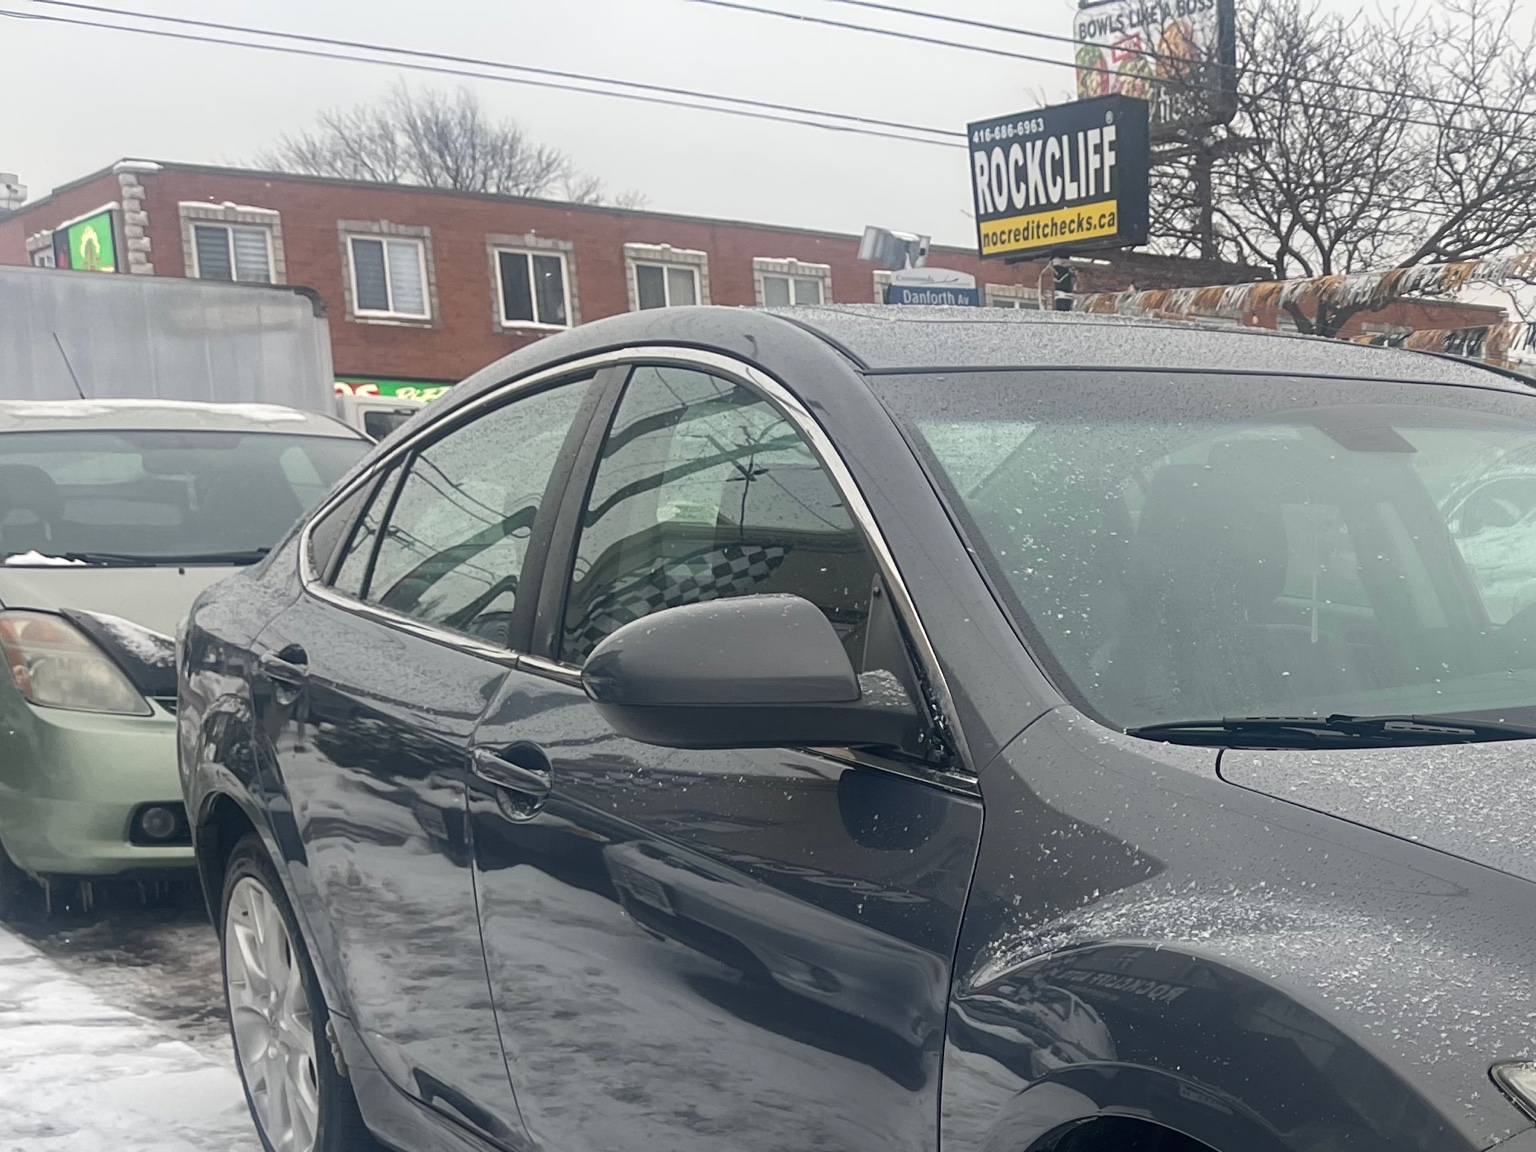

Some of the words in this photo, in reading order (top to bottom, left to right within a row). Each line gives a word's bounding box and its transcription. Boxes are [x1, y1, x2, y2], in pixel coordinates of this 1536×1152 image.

[1078, 14, 1125, 40] BOWLS
[972, 117, 1045, 144] 416-686-6963
[974, 124, 1117, 216] ROCKCLIFF
[983, 210, 1116, 248] nocreditchecks.ca
[903, 290, 954, 305] Danforth
[957, 295, 970, 305] Av
